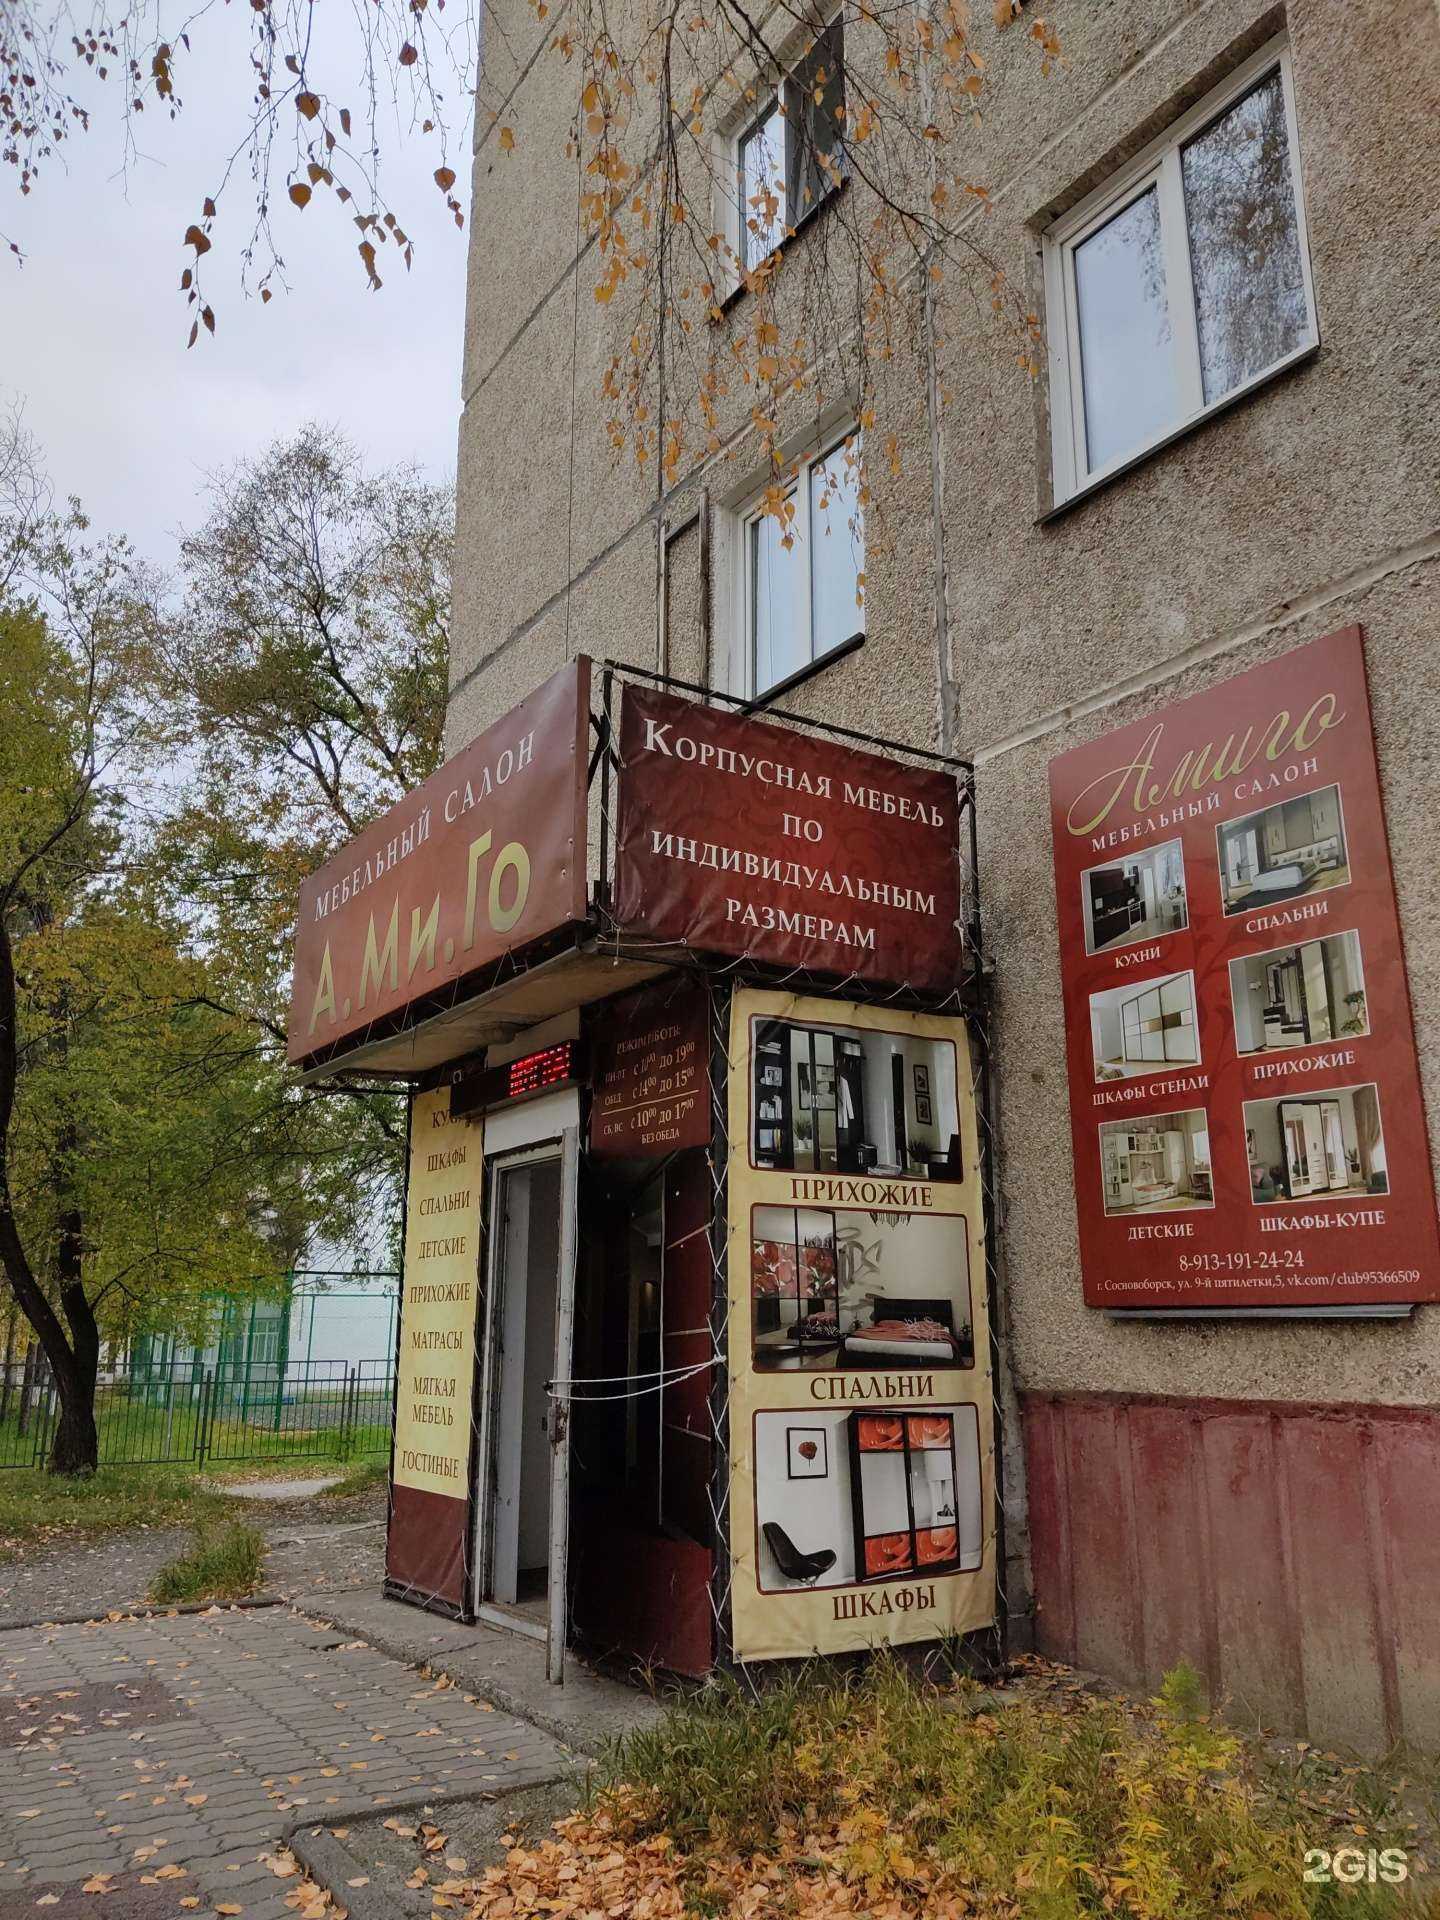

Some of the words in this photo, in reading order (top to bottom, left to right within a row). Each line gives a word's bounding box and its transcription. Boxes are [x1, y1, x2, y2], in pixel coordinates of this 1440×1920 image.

[1067, 693, 1346, 836] Амиго
[843, 782, 945, 828] МЕБЕЛЬ
[1092, 791, 1221, 852] МЕБЕЛЬНЫЙ
[1234, 757, 1319, 801] САЛОН
[313, 806, 431, 922] МЕБЕЛЬНЫЙ
[444, 730, 536, 823] САЛОН
[782, 812, 823, 842] ПО
[651, 830, 936, 916] ИНДИВИДУАЛЬНЫМ
[726, 898, 876, 950] РАЗМЕРАМ
[1246, 901, 1329, 934] СПАЛЬНИ
[1115, 946, 1161, 969] КУХНИ
[658, 1054, 673, 1069] до
[1253, 1051, 1355, 1080] ПРИХОЖИЕ
[658, 1078, 672, 1093] до
[1092, 1086, 1146, 1106] ШКАФЫ
[1149, 1075, 1209, 1097] СТЕНЛИ
[614, 1122, 624, 1133] ВС
[658, 1109, 672, 1124] до
[641, 1131, 655, 1145] БЕЗ
[655, 1127, 681, 1142] ОБЕДА
[427, 1146, 467, 1172] ШКАФЫ
[419, 1190, 470, 1216] СПАЛЬНИ
[790, 1178, 933, 1207] ПРИХОЖИЕ
[1128, 1224, 1194, 1241] ДЕТСКИЕ
[1260, 1210, 1386, 1232] ШКАФЫ-КУПЕ
[418, 1236, 466, 1259] ДЕТСКИЕ
[1179, 1250, 1304, 1271] 8-913-191-24-24
[409, 1282, 470, 1303] ПРИХОЖИЕ
[1104, 1279, 1176, 1292] Сосновоборск,
[1177, 1281, 1192, 1292] ул.
[1194, 1276, 1212, 1288] 9-й
[1288, 1269, 1420, 1287] vk.com/club95366509
[412, 1331, 464, 1350] МАТРАСЫ
[413, 1377, 456, 1397] МЯГКАЯ
[810, 1375, 935, 1400] СПАЛЬНИ
[412, 1404, 454, 1426] МЕБЕЛЬ
[402, 1450, 459, 1478] ГОСТИНЫЕ
[832, 1585, 936, 1621] ШКАФЫ
